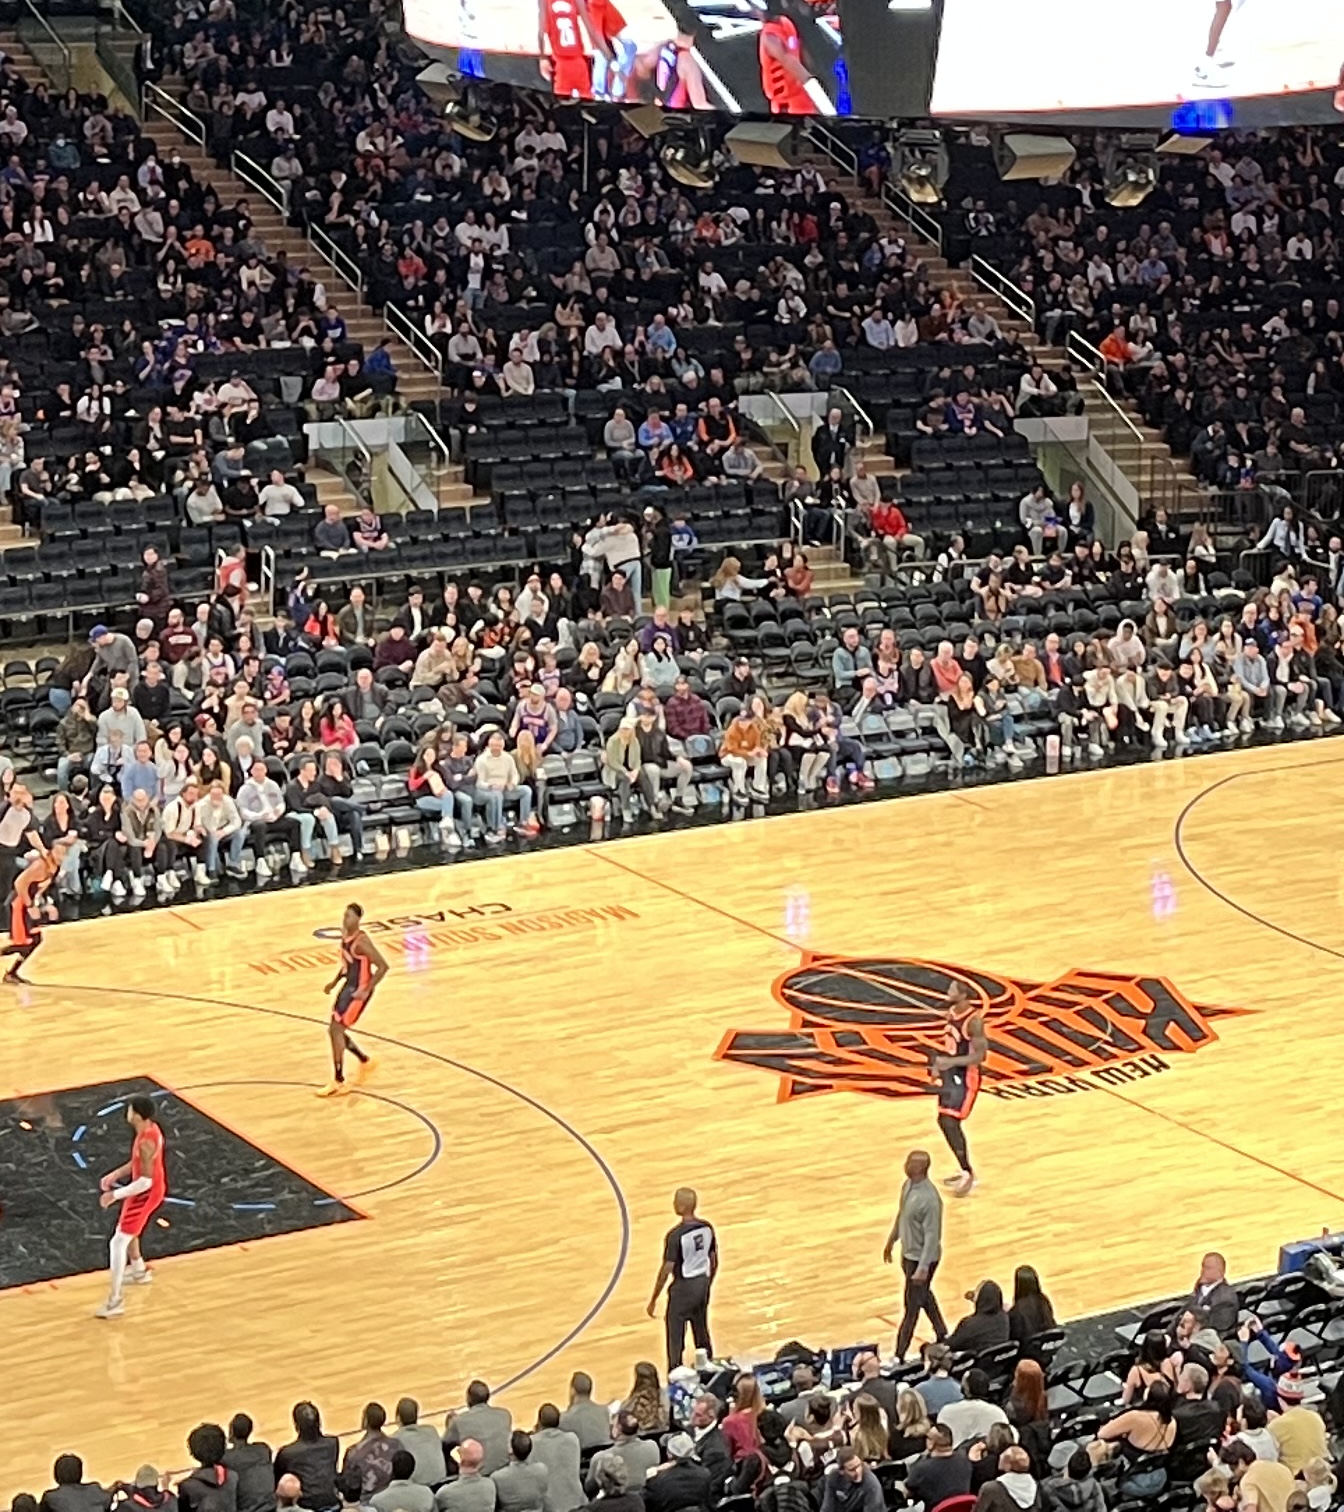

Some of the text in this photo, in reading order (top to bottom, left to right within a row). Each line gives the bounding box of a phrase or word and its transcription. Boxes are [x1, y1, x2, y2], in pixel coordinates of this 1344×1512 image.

[368, 901, 513, 934] CHASE
[509, 903, 641, 936] MADISON
[1089, 1052, 1173, 1085] NEW
